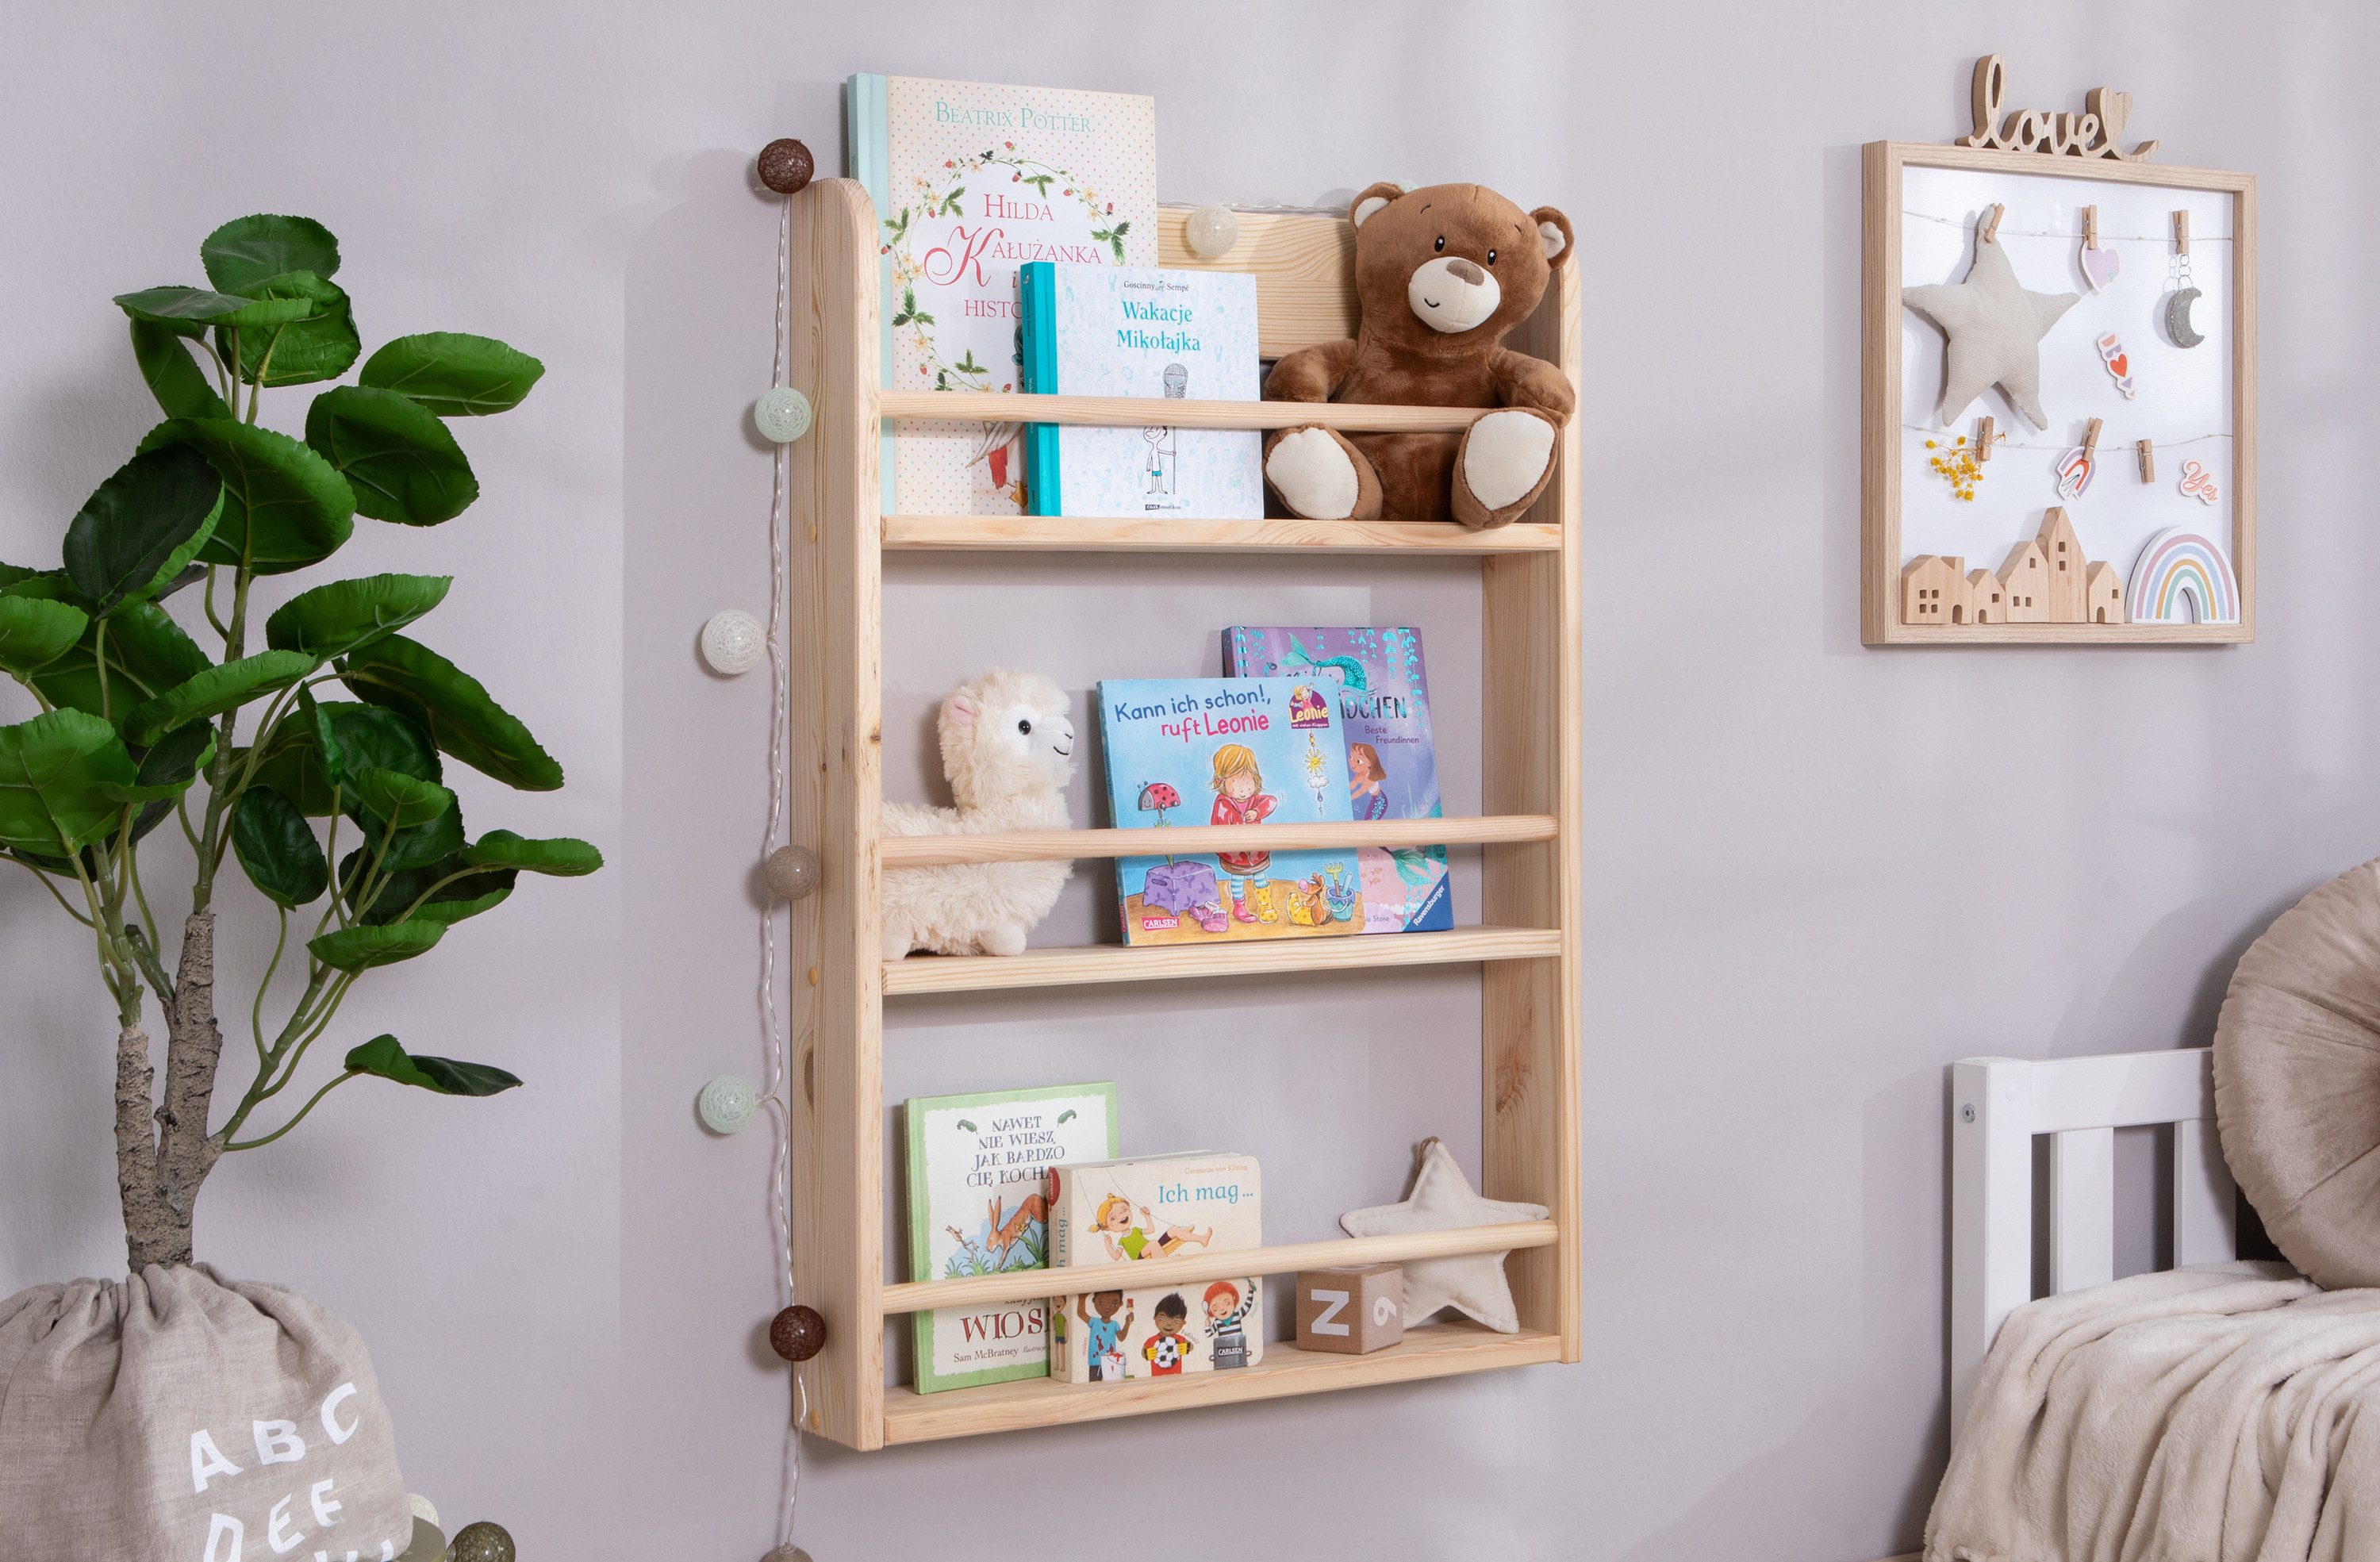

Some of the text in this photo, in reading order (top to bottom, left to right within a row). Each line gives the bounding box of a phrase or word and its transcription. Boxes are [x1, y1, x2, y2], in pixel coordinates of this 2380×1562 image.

[1955, 54, 2159, 163] love
[1012, 271, 1017, 289] i
[1123, 280, 1189, 293] Goscinny Sempé
[1122, 301, 1193, 326] Wakacje
[1116, 329, 1201, 354] Mikołajka
[2182, 461, 2218, 501] Yes
[1115, 702, 1166, 723] Kann
[1171, 694, 1199, 715] ich
[1288, 705, 1329, 723] Leonie
[1161, 708, 1269, 743] ruft Leonie
[1365, 725, 1388, 735] Beste
[1376, 735, 1419, 744] Freundinnen
[1413, 885, 1445, 927] Ravensburger
[1143, 919, 1178, 929] CARLSEN
[992, 1115, 1042, 1132] NAWET
[979, 1130, 1056, 1149] NIE WIESZ,
[971, 1146, 1065, 1172] JAK BARDZO
[966, 1172, 993, 1188] CIĘ
[1158, 1183, 1189, 1203] Ich
[959, 1307, 1050, 1343] WIOS
[954, 1353, 972, 1363] Sam
[974, 1347, 1019, 1361] McBratney
[1218, 1346, 1243, 1357] CARLSEN
